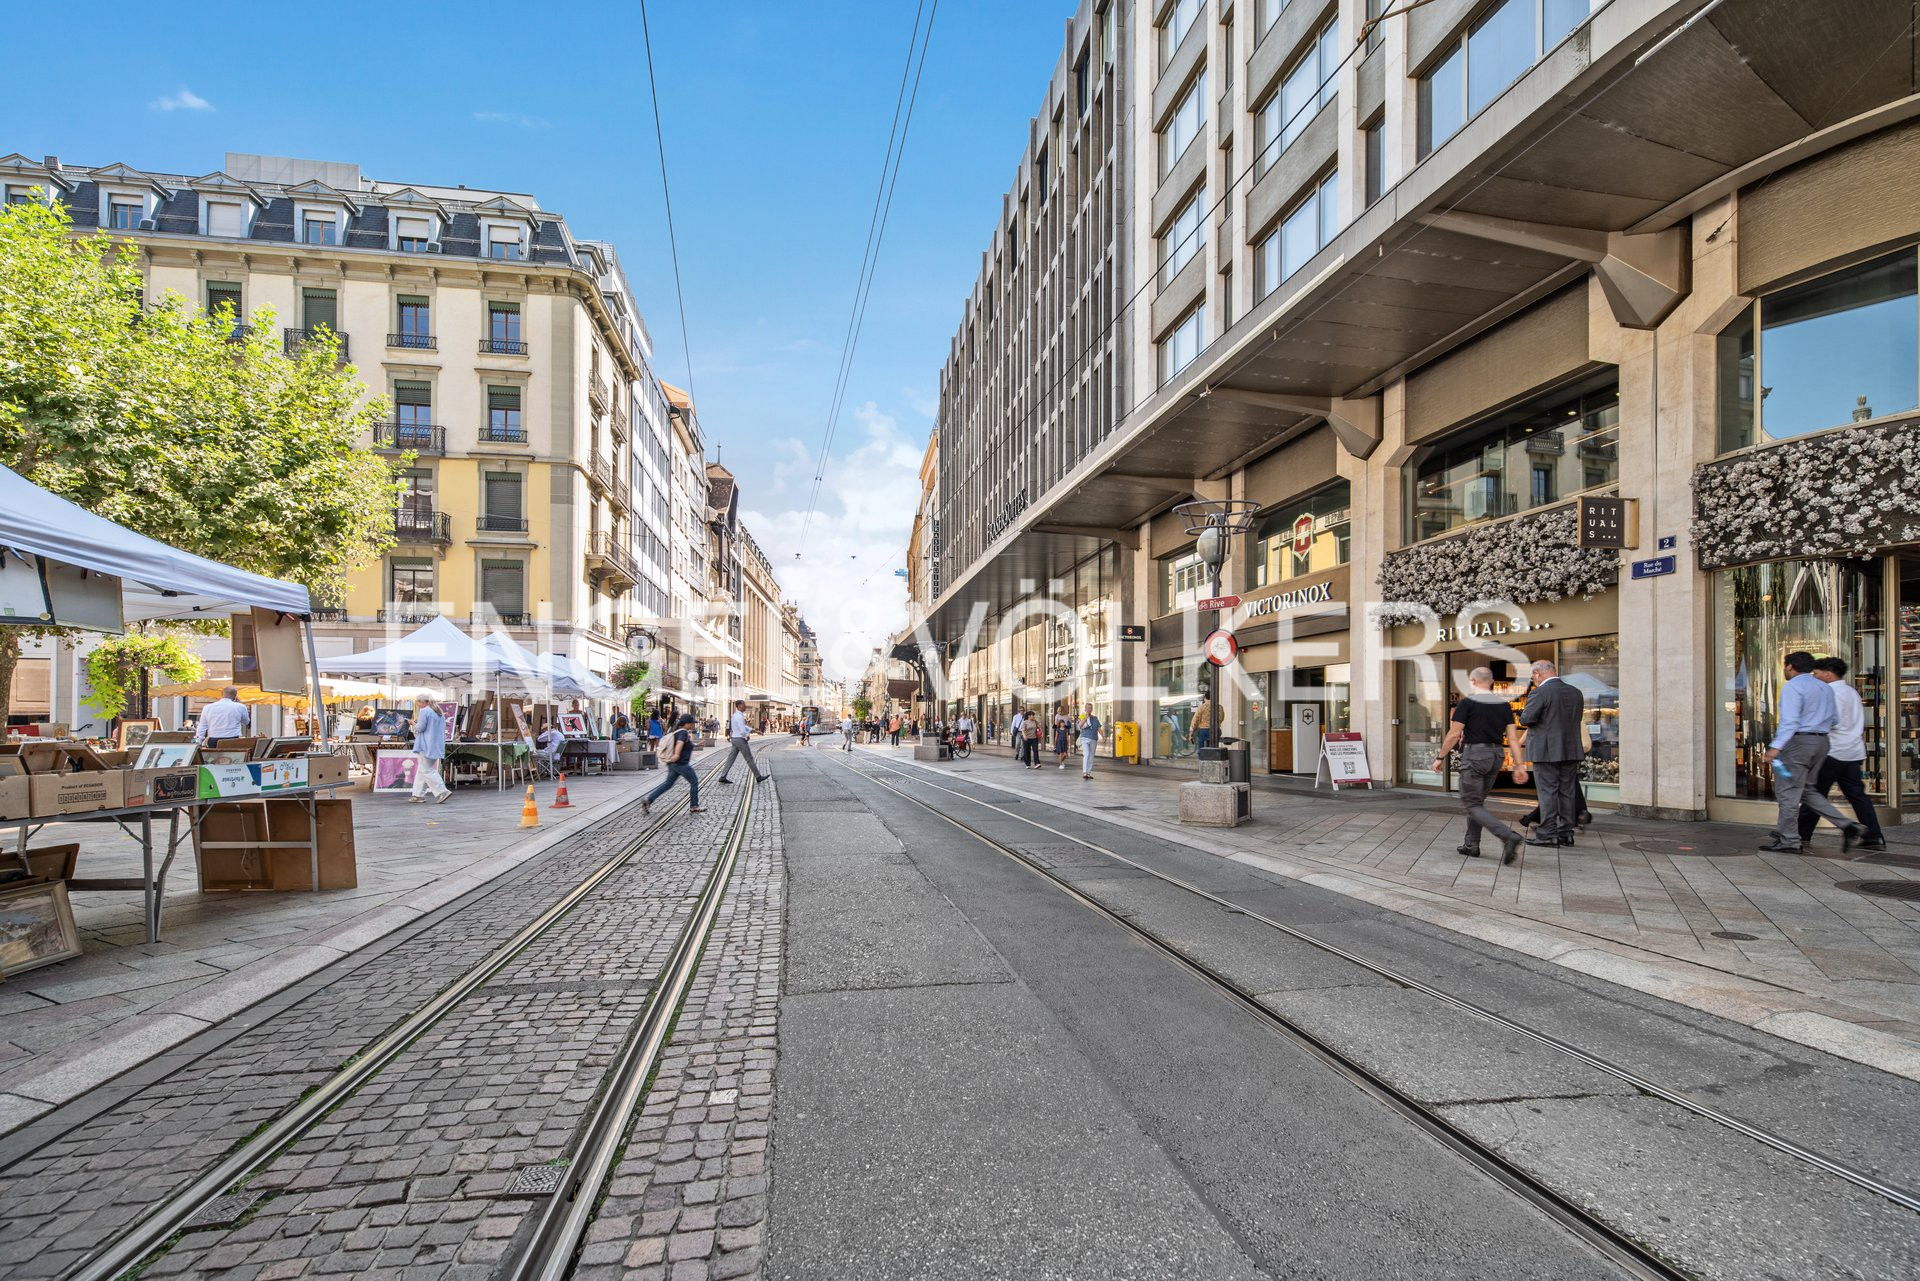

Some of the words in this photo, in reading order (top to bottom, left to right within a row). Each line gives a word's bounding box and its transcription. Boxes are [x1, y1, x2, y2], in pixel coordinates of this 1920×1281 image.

[1663, 538, 1670, 548] 2
[1209, 599, 1225, 609] Rive
[1244, 581, 1332, 618] VICTORINOX
